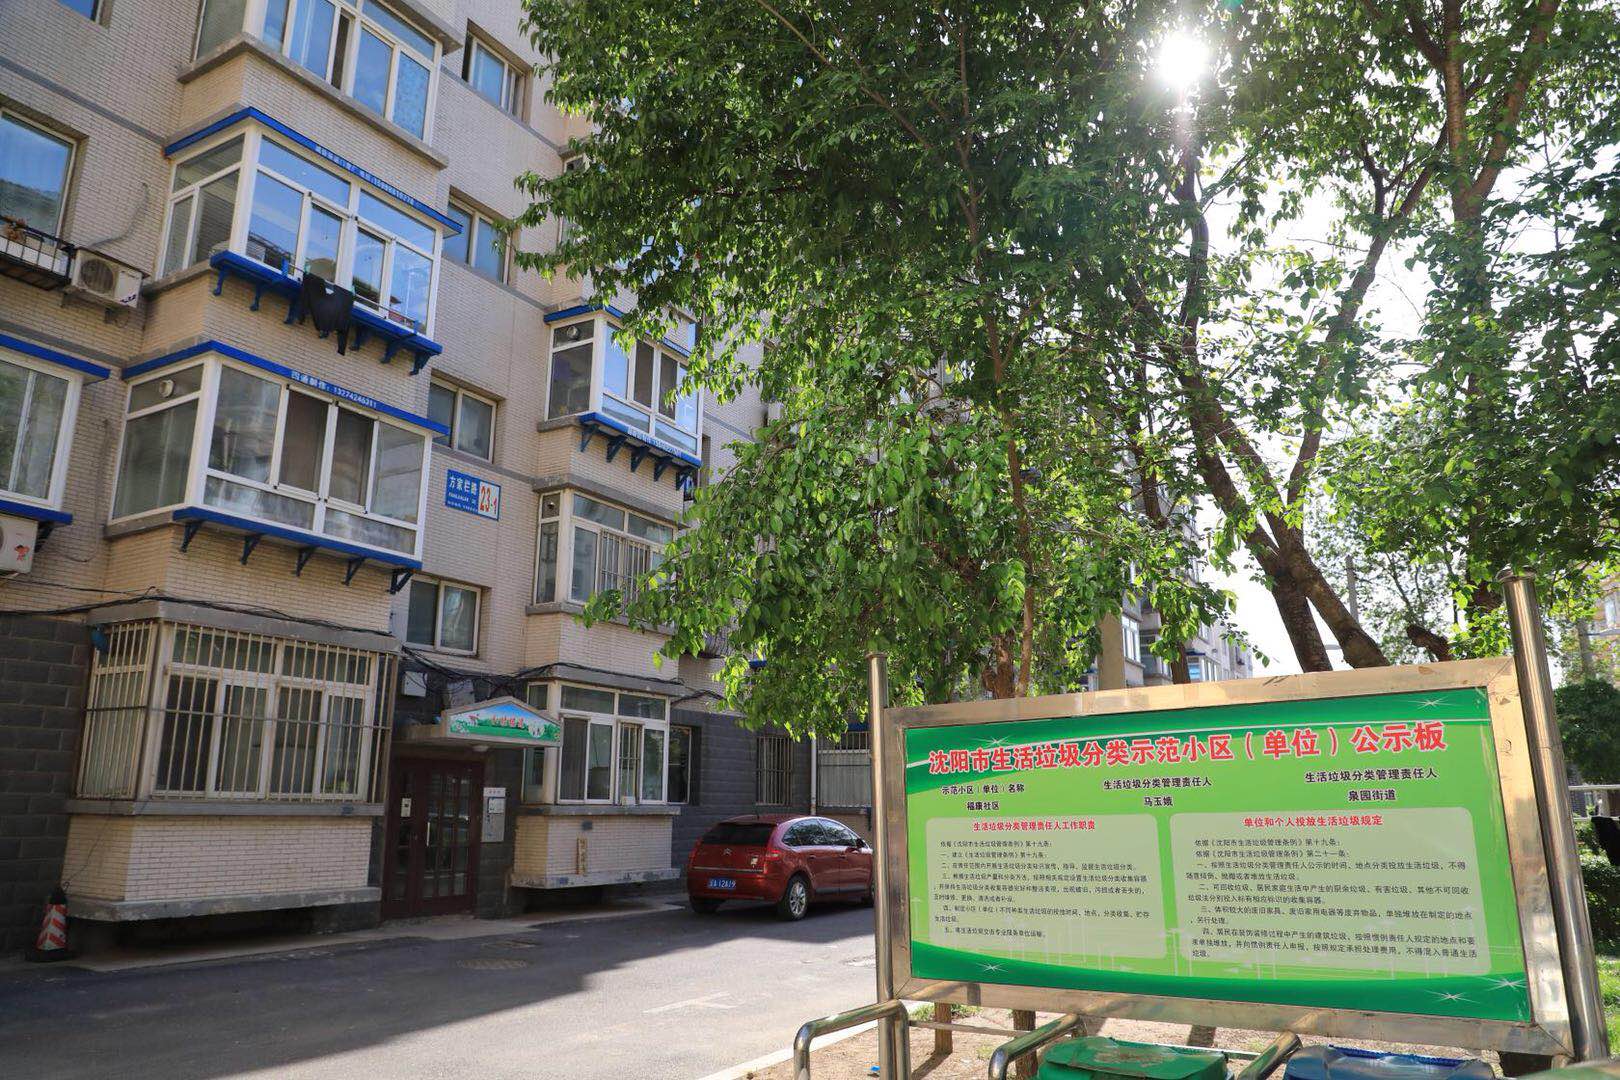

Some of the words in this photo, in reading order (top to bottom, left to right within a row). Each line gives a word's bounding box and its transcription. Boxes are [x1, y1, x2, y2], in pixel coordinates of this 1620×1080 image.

[928, 720, 1448, 774] 沈阳市生活垃圾分类示范小区（单位）公示板
[1304, 767, 1438, 783] 生活垃圾分类管理责任人
[1103, 776, 1213, 790] 生活垃圾分类管理责任人
[972, 818, 1096, 832] 生活垃圾分类管理责任人工作职责
[1243, 814, 1384, 828] 单位和个人投放生活垃圾规定
